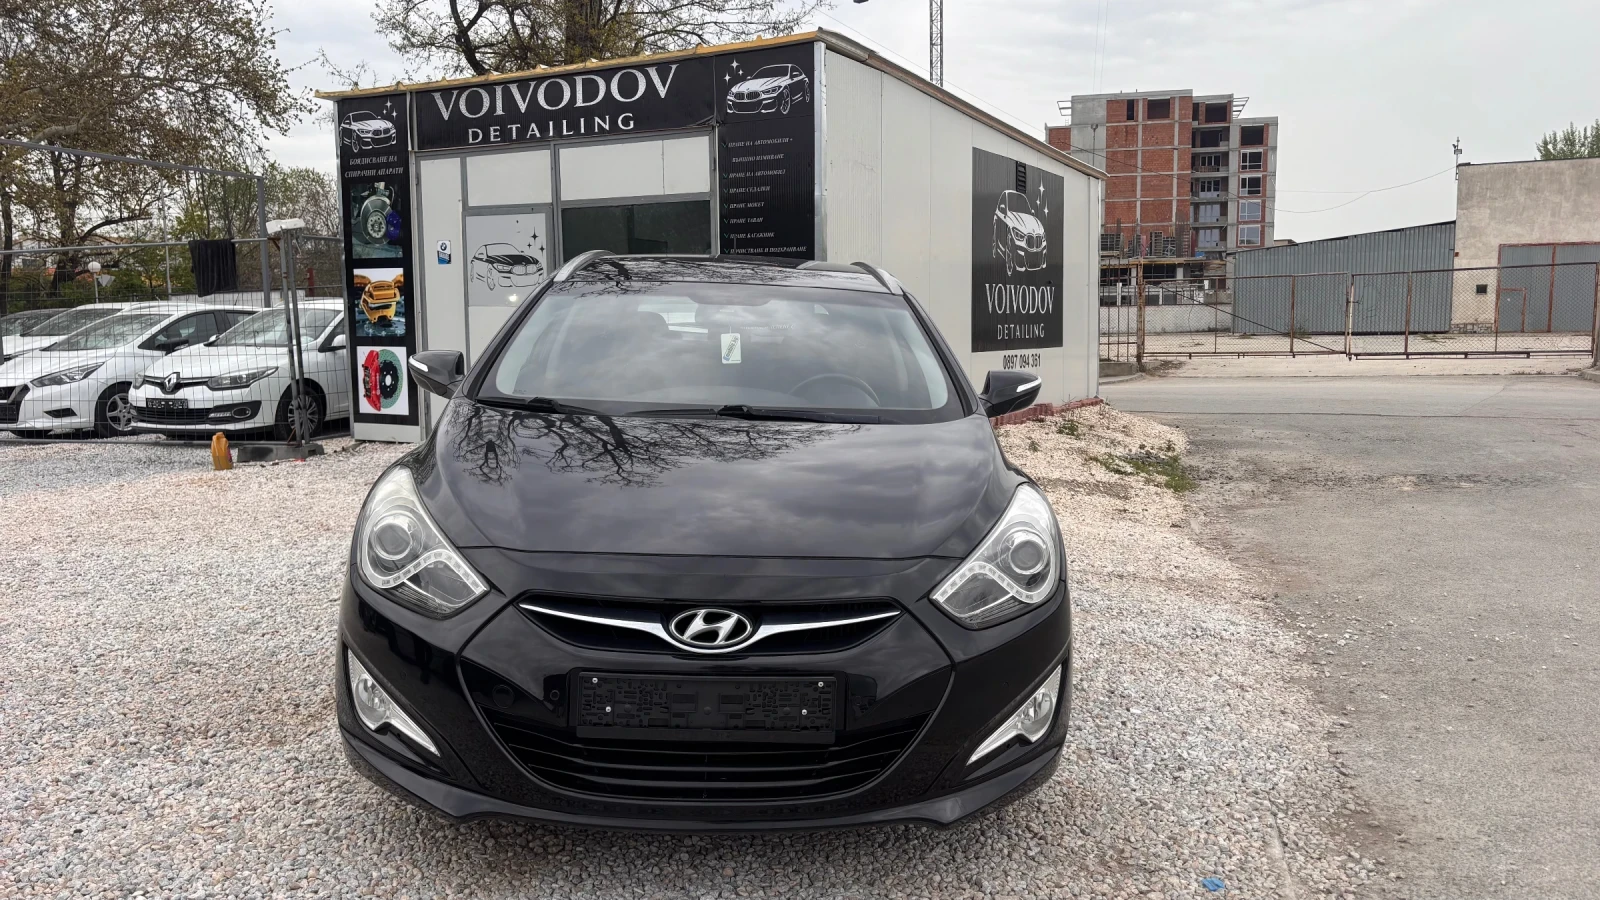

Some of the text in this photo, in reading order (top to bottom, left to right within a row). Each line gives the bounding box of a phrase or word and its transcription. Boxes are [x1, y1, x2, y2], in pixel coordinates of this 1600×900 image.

[430, 64, 680, 121] VOIVODOV
[468, 113, 635, 144] DETAILING
[349, 155, 398, 166] БОЯДИСВАНЕ НА
[344, 167, 404, 178] СПИРАЧНИ АПАРАТИ
[985, 283, 1055, 315] VOIVODOV
[997, 323, 1045, 340] DETAILING
[1003, 354, 1018, 370] 0897
[1019, 353, 1030, 369] 094
